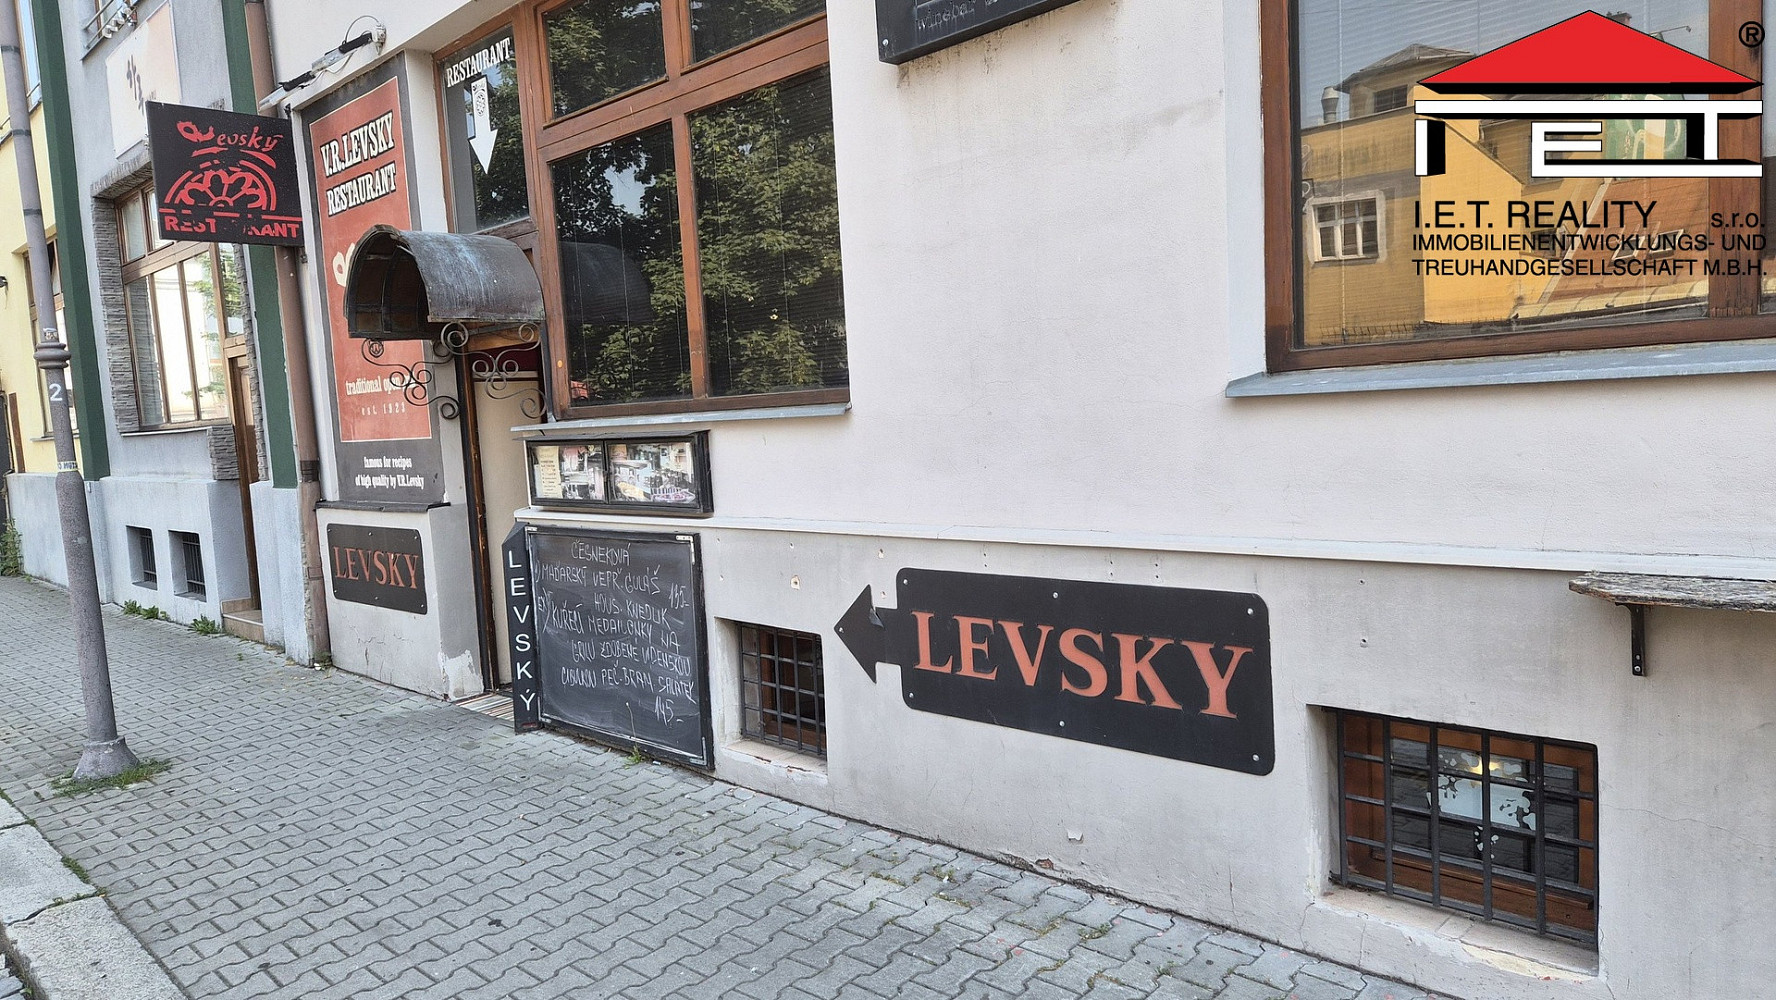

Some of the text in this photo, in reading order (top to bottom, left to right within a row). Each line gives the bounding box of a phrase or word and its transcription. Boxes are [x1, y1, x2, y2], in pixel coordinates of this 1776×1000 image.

[446, 37, 510, 88] RESTAURANT
[326, 160, 396, 217] RESTAURANT
[49, 383, 62, 401] 2
[345, 375, 382, 395] traditional
[364, 456, 412, 471] famous for recipes
[361, 474, 371, 489] high
[372, 474, 389, 489] quality
[390, 474, 396, 489] by
[333, 546, 418, 590] LEVSKY
[508, 551, 536, 711] LEVSKÝ
[661, 631, 680, 656] NA
[910, 610, 1254, 719] LEVSKY
